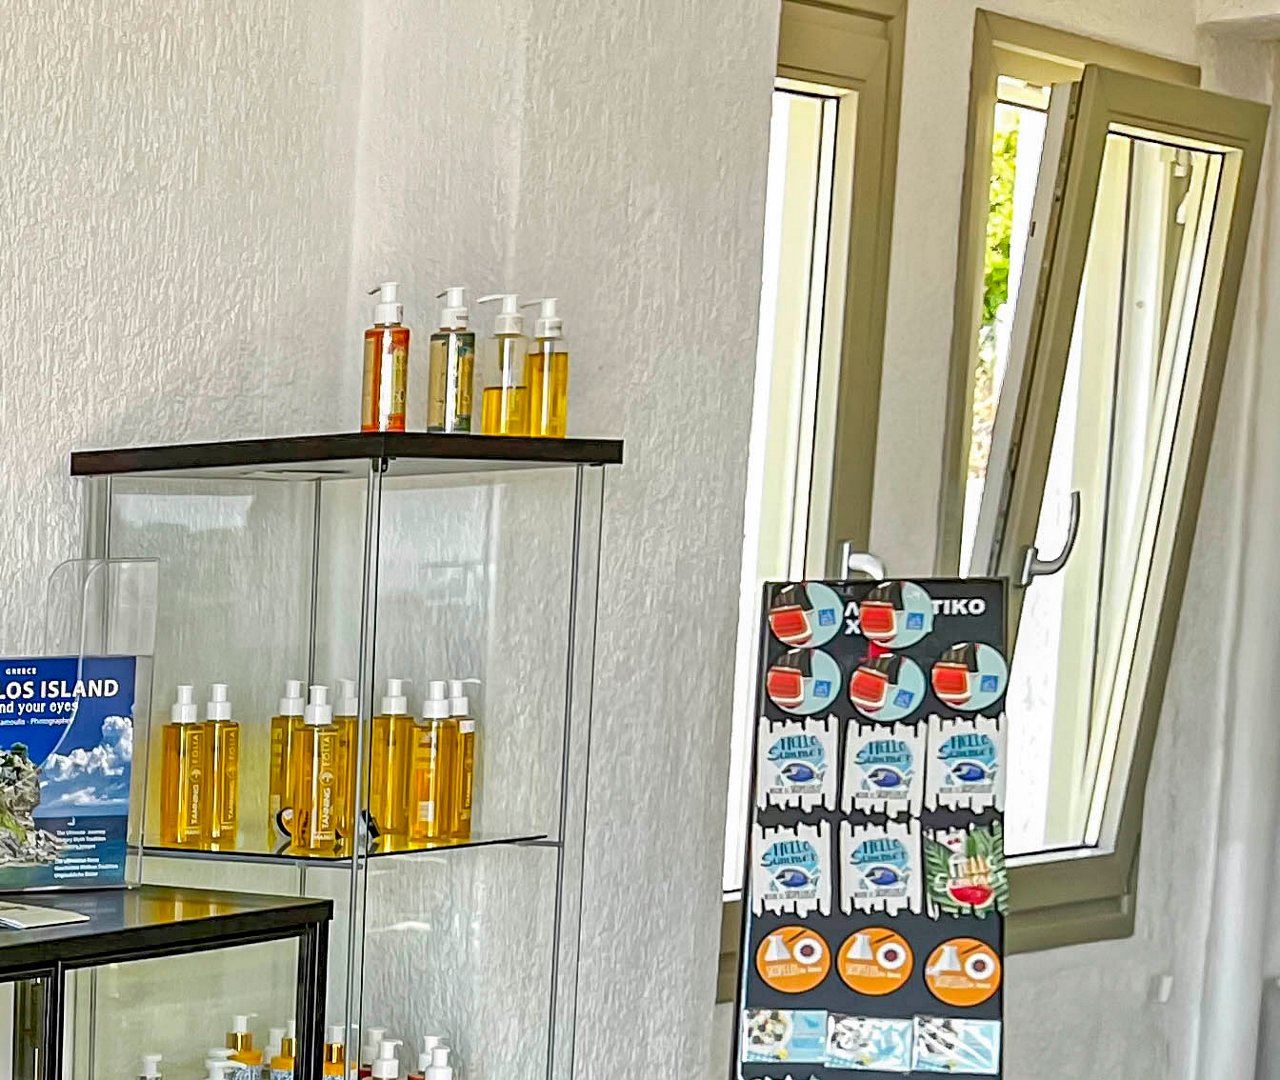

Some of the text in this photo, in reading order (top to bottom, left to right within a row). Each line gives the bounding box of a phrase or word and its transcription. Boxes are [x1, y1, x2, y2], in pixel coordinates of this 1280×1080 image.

[41, 679, 119, 699] ISLAND
[18, 702, 45, 716] your
[50, 702, 78, 714] eyes
